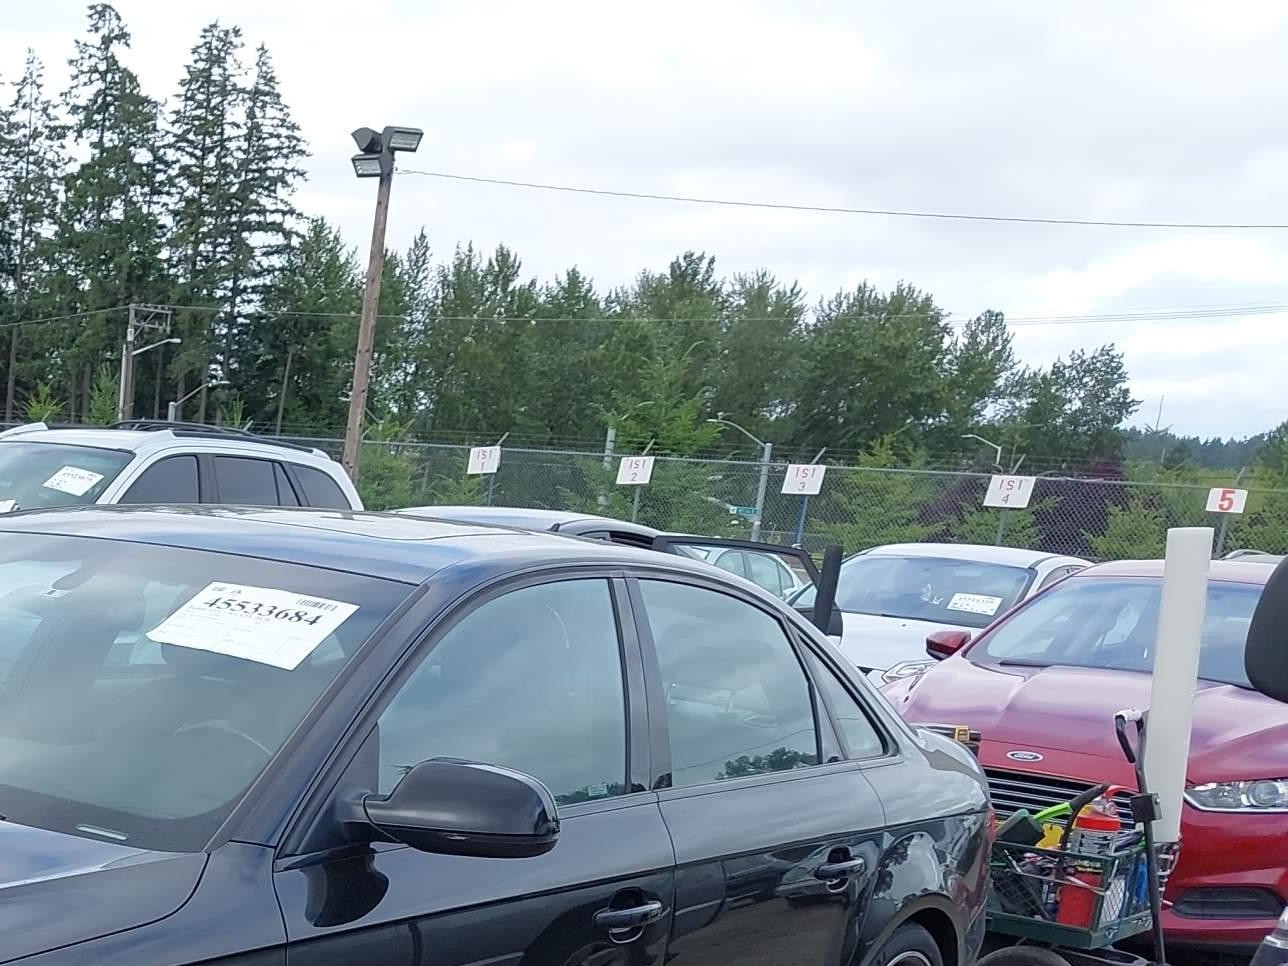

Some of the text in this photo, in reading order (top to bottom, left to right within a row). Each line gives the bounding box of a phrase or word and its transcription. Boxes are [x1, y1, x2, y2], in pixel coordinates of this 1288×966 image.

[630, 472, 638, 482] 2
[797, 481, 806, 492] 3
[1001, 493, 1010, 505] 4
[1218, 489, 1236, 511] 5
[204, 596, 323, 626] 45533684
